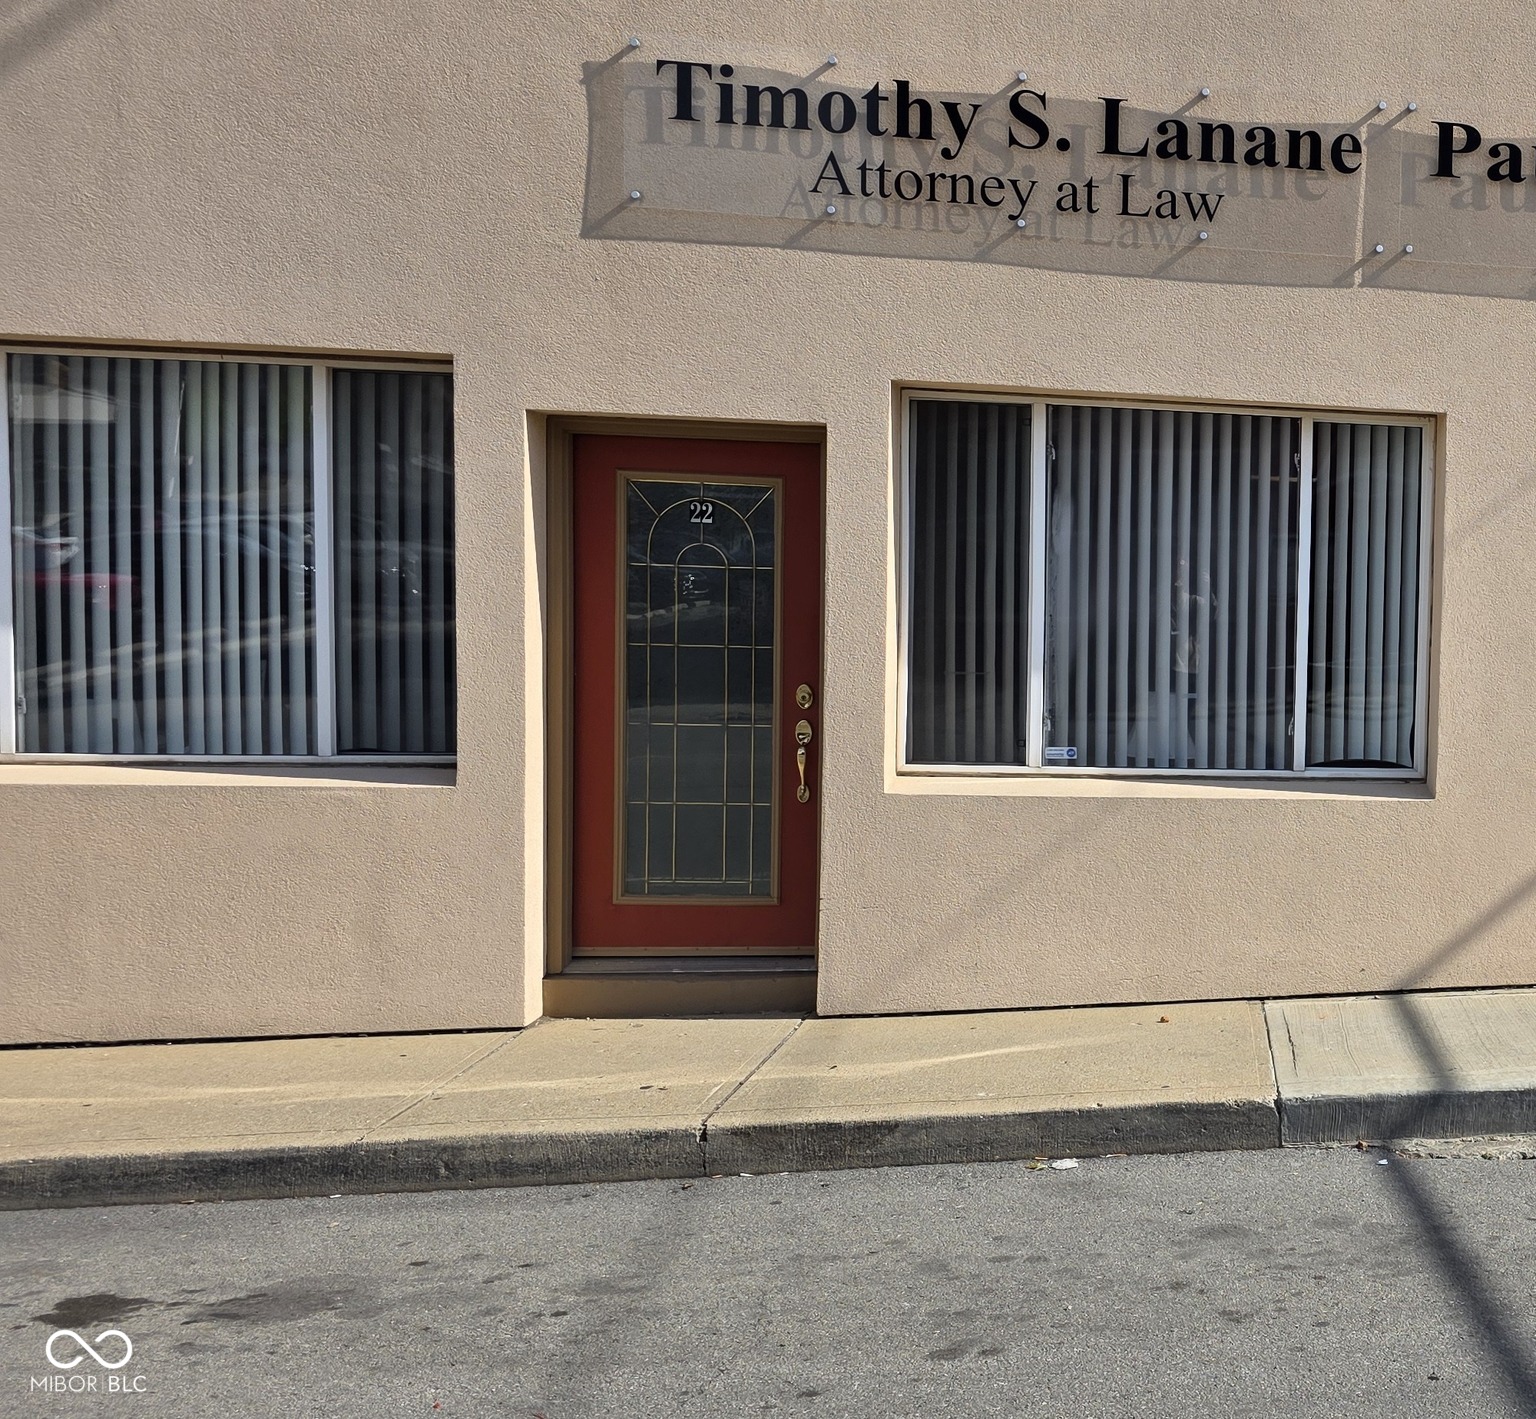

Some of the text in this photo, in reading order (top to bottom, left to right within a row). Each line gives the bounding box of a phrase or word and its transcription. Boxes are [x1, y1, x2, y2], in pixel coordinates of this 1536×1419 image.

[656, 58, 1364, 174] Timothy S. Lanane
[809, 150, 1226, 223] Attorney at Law
[690, 501, 713, 523] 22
